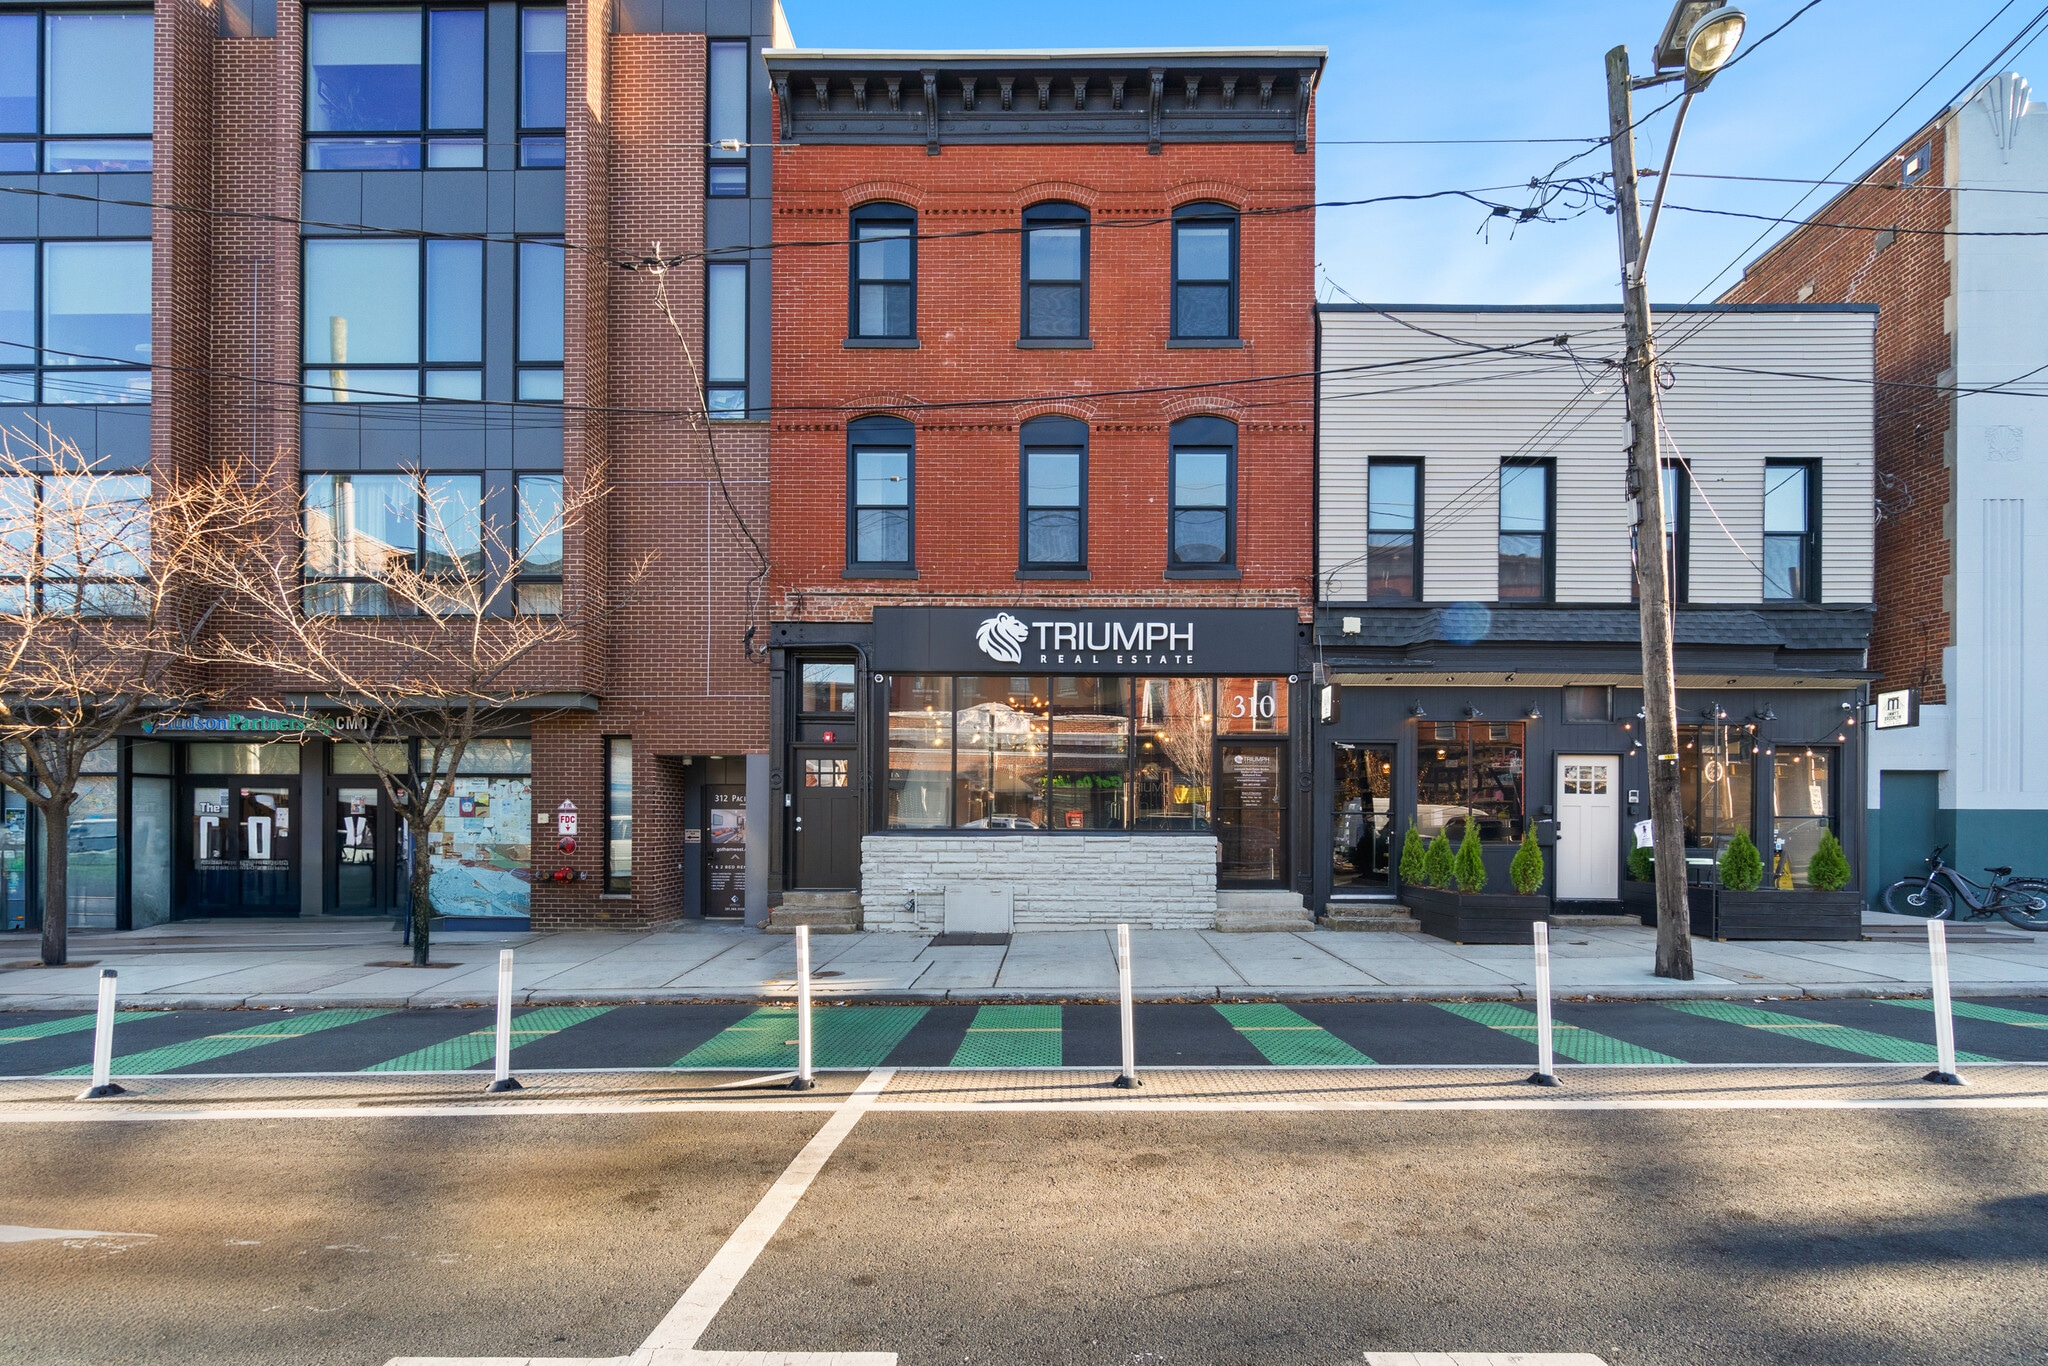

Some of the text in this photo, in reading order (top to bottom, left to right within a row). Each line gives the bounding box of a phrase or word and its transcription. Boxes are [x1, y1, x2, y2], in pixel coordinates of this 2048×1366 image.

[1032, 622, 1194, 650] TRIUMPH
[1040, 654, 1193, 664] REAL ESTATE
[1231, 695, 1276, 718] 310
[714, 794, 729, 802] 312
[200, 802, 221, 813] The
[560, 815, 576, 824] FDC
